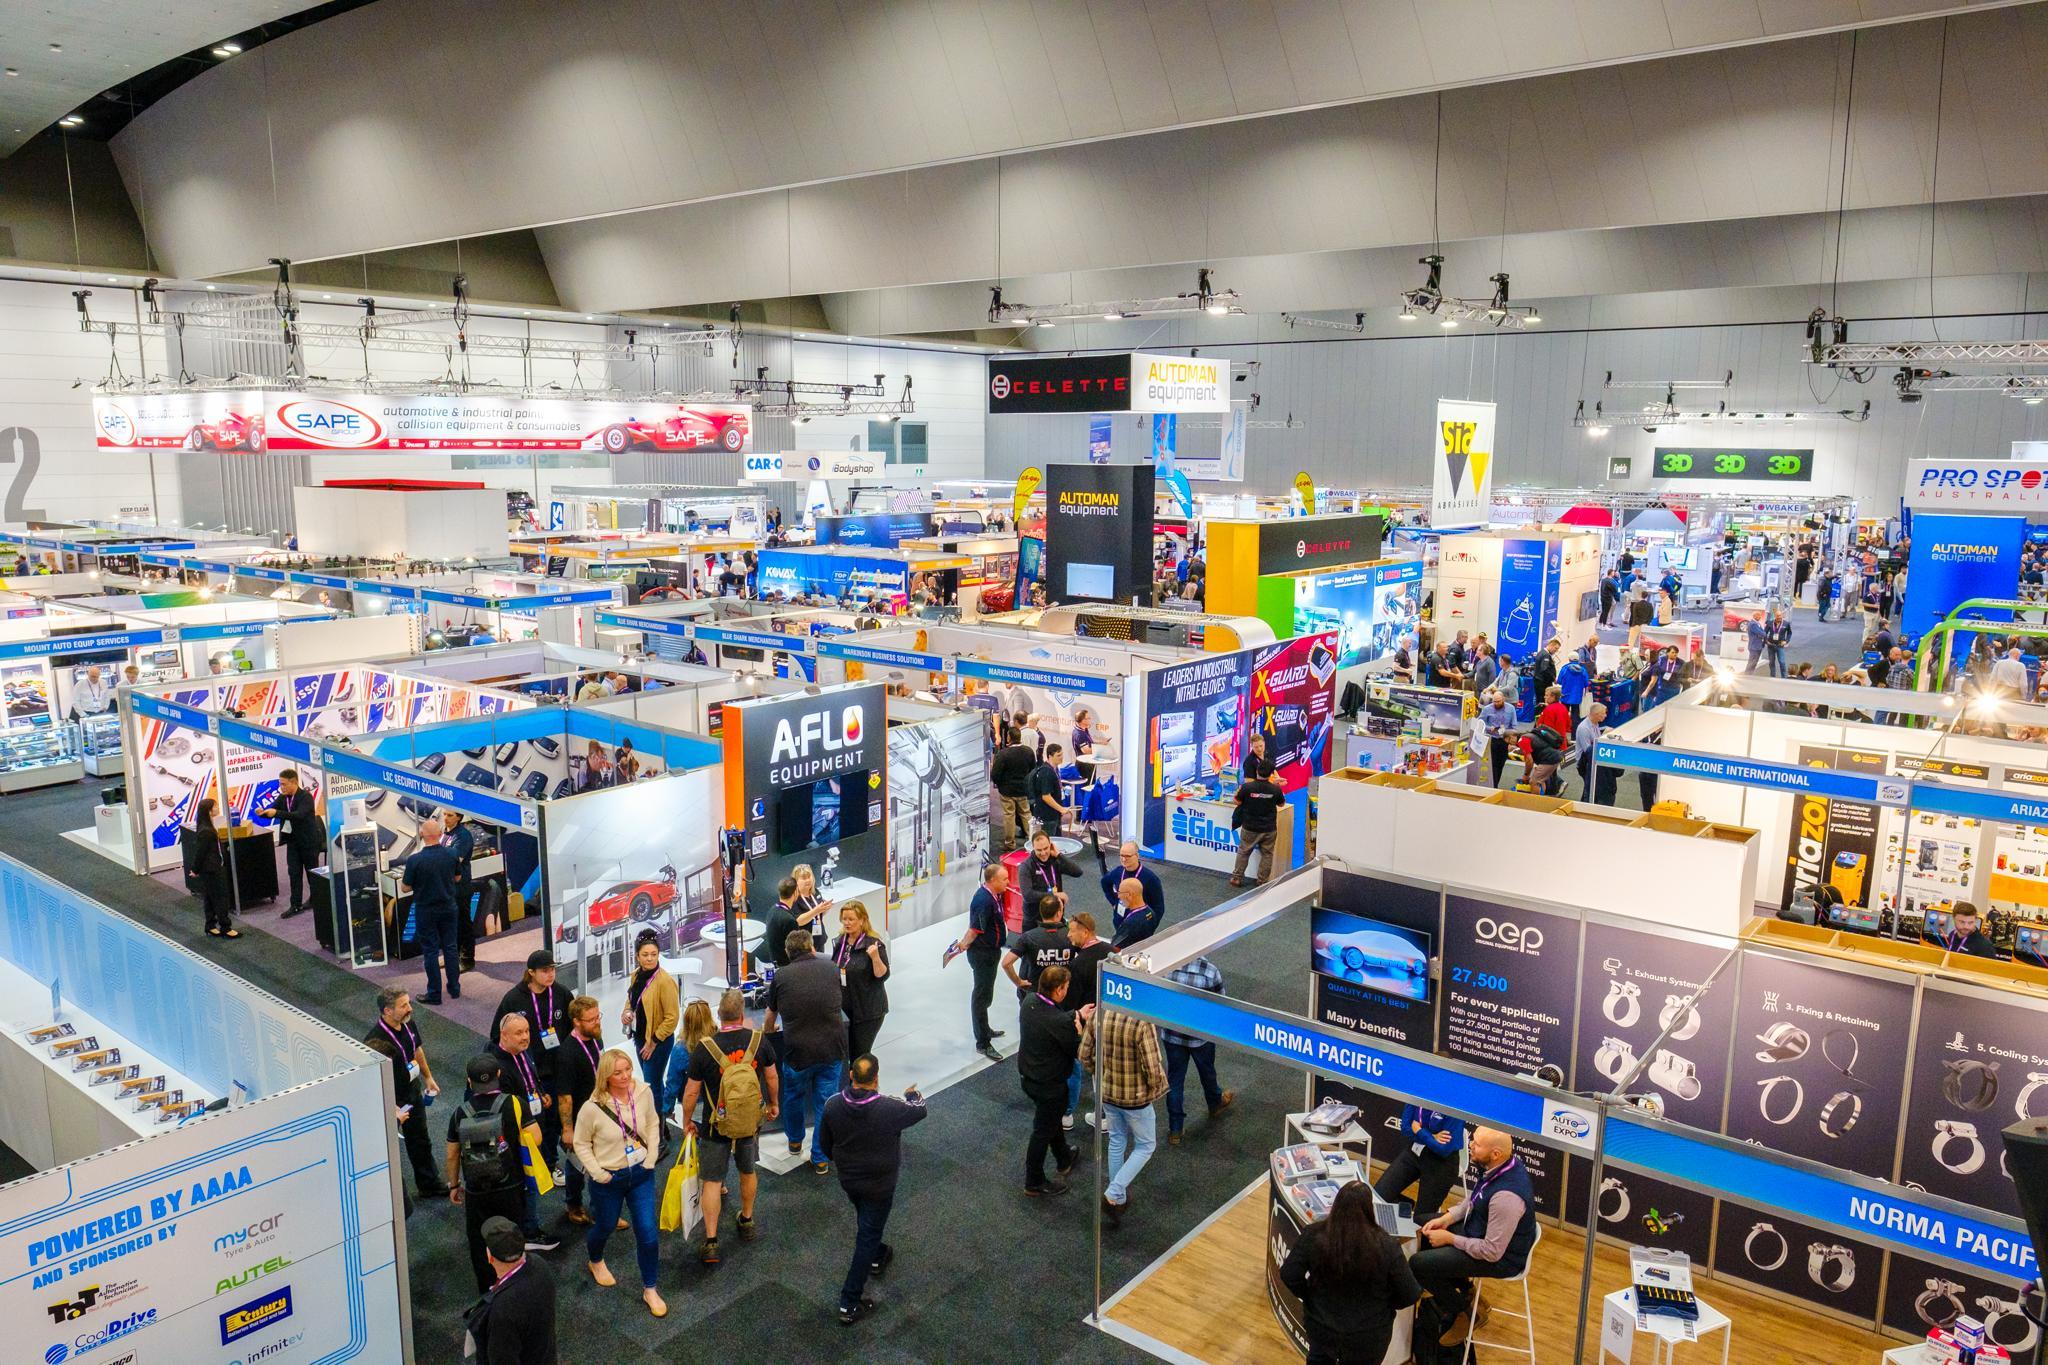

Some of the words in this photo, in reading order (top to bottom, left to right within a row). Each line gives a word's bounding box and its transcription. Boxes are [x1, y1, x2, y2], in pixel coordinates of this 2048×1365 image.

[1149, 362, 1217, 384] AUTOMAN
[1013, 377, 1126, 394] CELETTE
[1149, 384, 1216, 404] equipment
[104, 415, 127, 429] SAPE
[297, 413, 361, 429] SAPE
[383, 406, 449, 417] automotive
[463, 407, 513, 418] industrial
[397, 418, 443, 430] collision
[446, 418, 503, 432] equipment
[666, 429, 705, 443] SAPE
[1443, 421, 1477, 455] sia
[1663, 454, 1693, 473] 3D
[1714, 454, 1746, 474] 3D
[1768, 455, 1801, 475] 3D
[1920, 469, 1978, 488] PRO
[1059, 491, 1119, 506] AUTOMAN
[1059, 503, 1119, 517] equipment
[1752, 504, 1799, 514] LOWBAKE
[1931, 543, 1998, 556] AUTOMAN
[1931, 553, 1996, 563] equipment
[223, 626, 245, 634] MOUNT
[246, 625, 263, 633] AUTO
[24, 641, 50, 653] MOUNT
[53, 641, 72, 651] AUTO
[74, 638, 95, 649] EQUIP
[97, 636, 130, 646] SERVICES
[843, 648, 872, 658] MARKINSON
[872, 651, 896, 662] BUSINESS
[897, 654, 925, 666] SOLUTIONS
[1055, 650, 1106, 667] markinson
[1255, 648, 1269, 663] NEW
[988, 667, 1022, 679] MARKINSON
[1023, 672, 1051, 683] BUSINESS
[1053, 676, 1086, 688] SOLUTIONS
[1162, 665, 1193, 688] LEADERS
[1193, 664, 1201, 681] IN
[1201, 657, 1237, 679] INDUSTRIAL
[1175, 684, 1201, 704] NITRILE
[1200, 677, 1226, 698] GLOVES
[1255, 664, 1309, 704] X-GUARD
[264, 734, 278, 748] JAPAN
[227, 753, 255, 766] JAPANESE
[1599, 747, 1616, 759] C41
[227, 765, 239, 774] CAR
[240, 762, 263, 773] MODELS
[770, 749, 864, 785] EQUIPMENT
[1673, 757, 1723, 774] ARIAZONE
[1726, 764, 1810, 787] INTERNATIONAL
[383, 770, 393, 783] LSC
[394, 774, 420, 791] SECURITY
[421, 782, 454, 801] SOLUTIONS
[1188, 807, 1206, 818] The
[2010, 803, 2048, 819] ARIAZ
[1188, 816, 1241, 845] Glov
[1188, 836, 1239, 853] compan
[1452, 967, 1509, 993] 27,500
[1626, 968, 1634, 976] 1.
[1635, 969, 1668, 984] Exhaust
[1106, 979, 1133, 1001] D43
[1328, 982, 1361, 998] QUALITY
[1388, 999, 1409, 1010] BEST
[1451, 992, 1468, 1004] For
[1470, 997, 1499, 1013] every
[1500, 1004, 1560, 1026] application
[1785, 1002, 1794, 1011] 3.
[1796, 1004, 1824, 1020] Fixing
[1825, 1011, 1833, 1020] &
[1834, 1012, 1880, 1031] Retaining
[1327, 1009, 1357, 1029] Many
[1360, 1019, 1407, 1041] benefits
[1449, 1016, 1465, 1025] over
[1466, 1019, 1491, 1032] 27,500
[1491, 1027, 1503, 1035] car
[1526, 1035, 1539, 1043] car
[1450, 1006, 1466, 1017] With
[1480, 1012, 1501, 1025] broad
[1502, 1020, 1531, 1032] portfolio
[1532, 1027, 1541, 1035] of
[1448, 1034, 1462, 1043] and
[1463, 1036, 1482, 1049] fixing
[1483, 1042, 1515, 1056] solutions
[1516, 1050, 1526, 1059] for
[1527, 1055, 1544, 1064] over
[1449, 1024, 1486, 1039] mechanics
[1487, 1034, 1500, 1043] can
[1501, 1037, 1515, 1048] find
[1516, 1041, 1541, 1054] joining
[1254, 1022, 1314, 1057] NORMA
[1318, 1041, 1384, 1078] PACIFIC
[1449, 1042, 1462, 1052] 100
[1463, 1046, 1501, 1062] automotive
[1977, 1043, 1987, 1052] 5.
[1988, 1046, 2030, 1064] Cooling
[1553, 1125, 1578, 1139] EXPO
[1517, 1145, 1546, 1158] material
[1525, 1155, 1541, 1167] This
[28, 1205, 143, 1267] POWERED
[150, 1189, 183, 1221] BY
[190, 1166, 253, 1206] AAAA
[213, 1212, 284, 1253] mycar
[1850, 1196, 1946, 1244] NORMA
[1956, 1227, 2039, 1272] PACIF
[224, 1247, 243, 1259] Tyre
[245, 1242, 252, 1251] &
[254, 1233, 275, 1247] Auto
[32, 1267, 63, 1290] AND
[69, 1235, 153, 1277] SPONSORED
[158, 1223, 177, 1241] BY
[215, 1256, 292, 1295] AUTEL
[98, 1279, 138, 1298] Automotive
[104, 1284, 139, 1301] Technician
[105, 1282, 117, 1290] The
[75, 1308, 157, 1348] CoolDrive
[248, 1331, 304, 1365] infinitev
